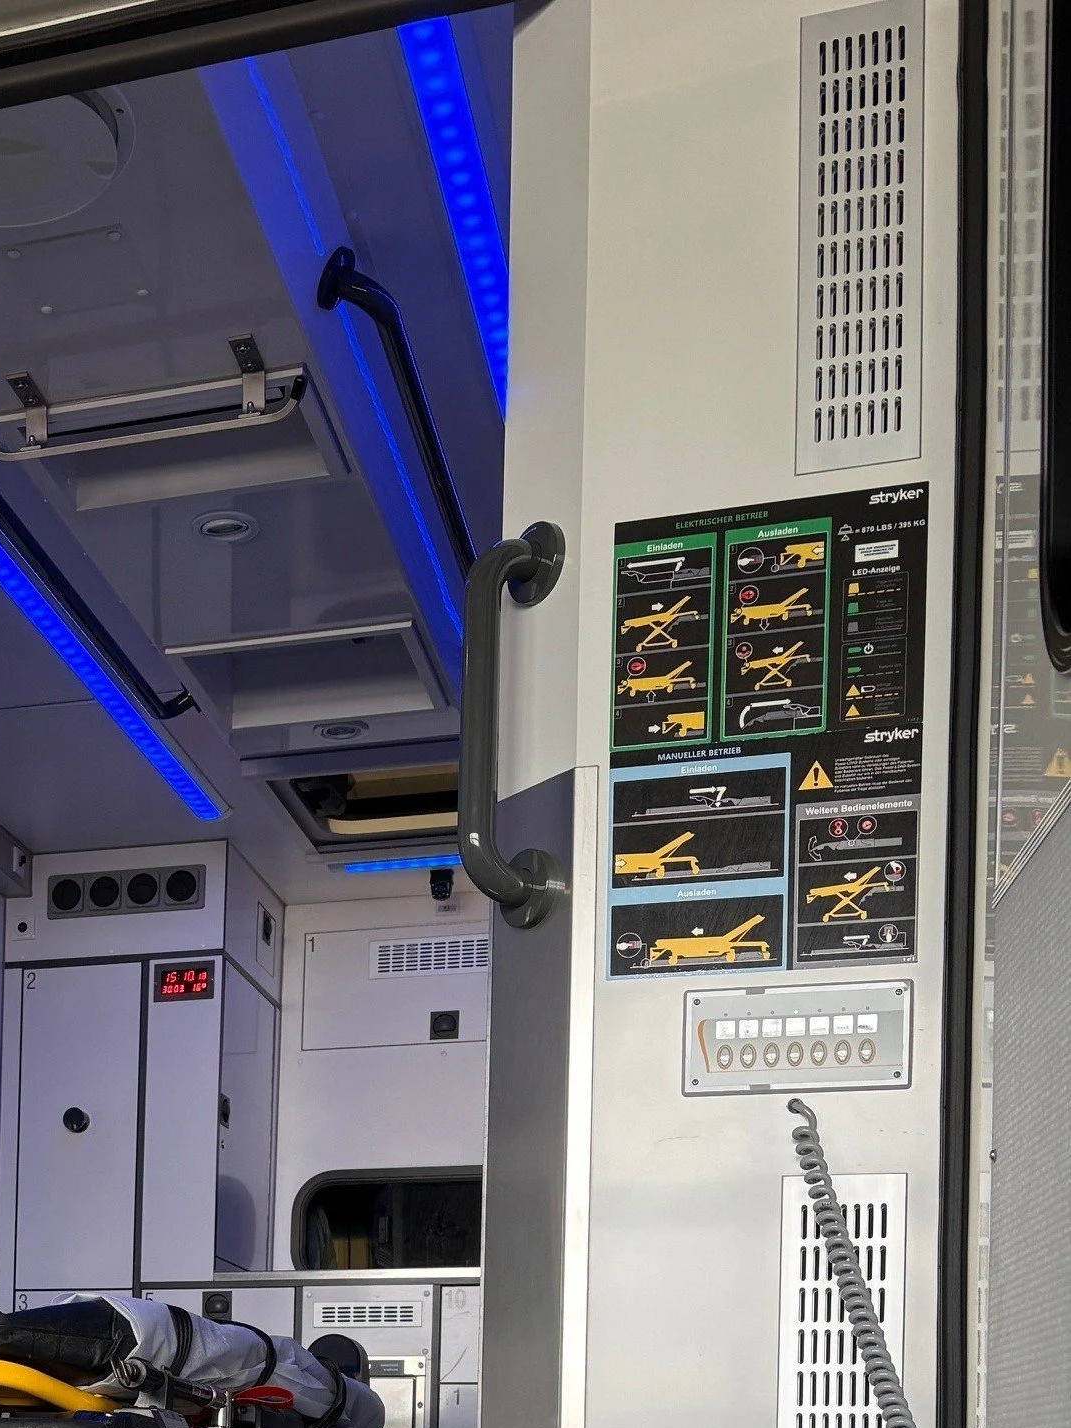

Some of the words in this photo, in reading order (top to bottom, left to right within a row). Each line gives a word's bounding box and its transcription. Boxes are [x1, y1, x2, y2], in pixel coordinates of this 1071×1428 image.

[869, 488, 924, 505] stryker
[675, 515, 733, 529] ELEKTRISCHER
[735, 510, 769, 521] BETRIEB
[861, 525, 875, 534] 870
[876, 523, 892, 532] LBS
[898, 520, 912, 529] 395
[913, 519, 926, 527] KG
[757, 526, 799, 538] Ausladen
[646, 541, 684, 552] Einladen
[852, 565, 901, 577] LED-Anzeige
[863, 727, 919, 743] stryker
[657, 750, 706, 761] MANUELLER
[709, 746, 741, 757] BETRIEB
[680, 764, 718, 774] Einladen
[805, 806, 839, 816] Weitere
[840, 800, 913, 813] Bedienelemente
[677, 888, 717, 898] Ausladen
[308, 936, 315, 952] 1
[27, 972, 36, 989] 2
[18, 1294, 28, 1311] 3
